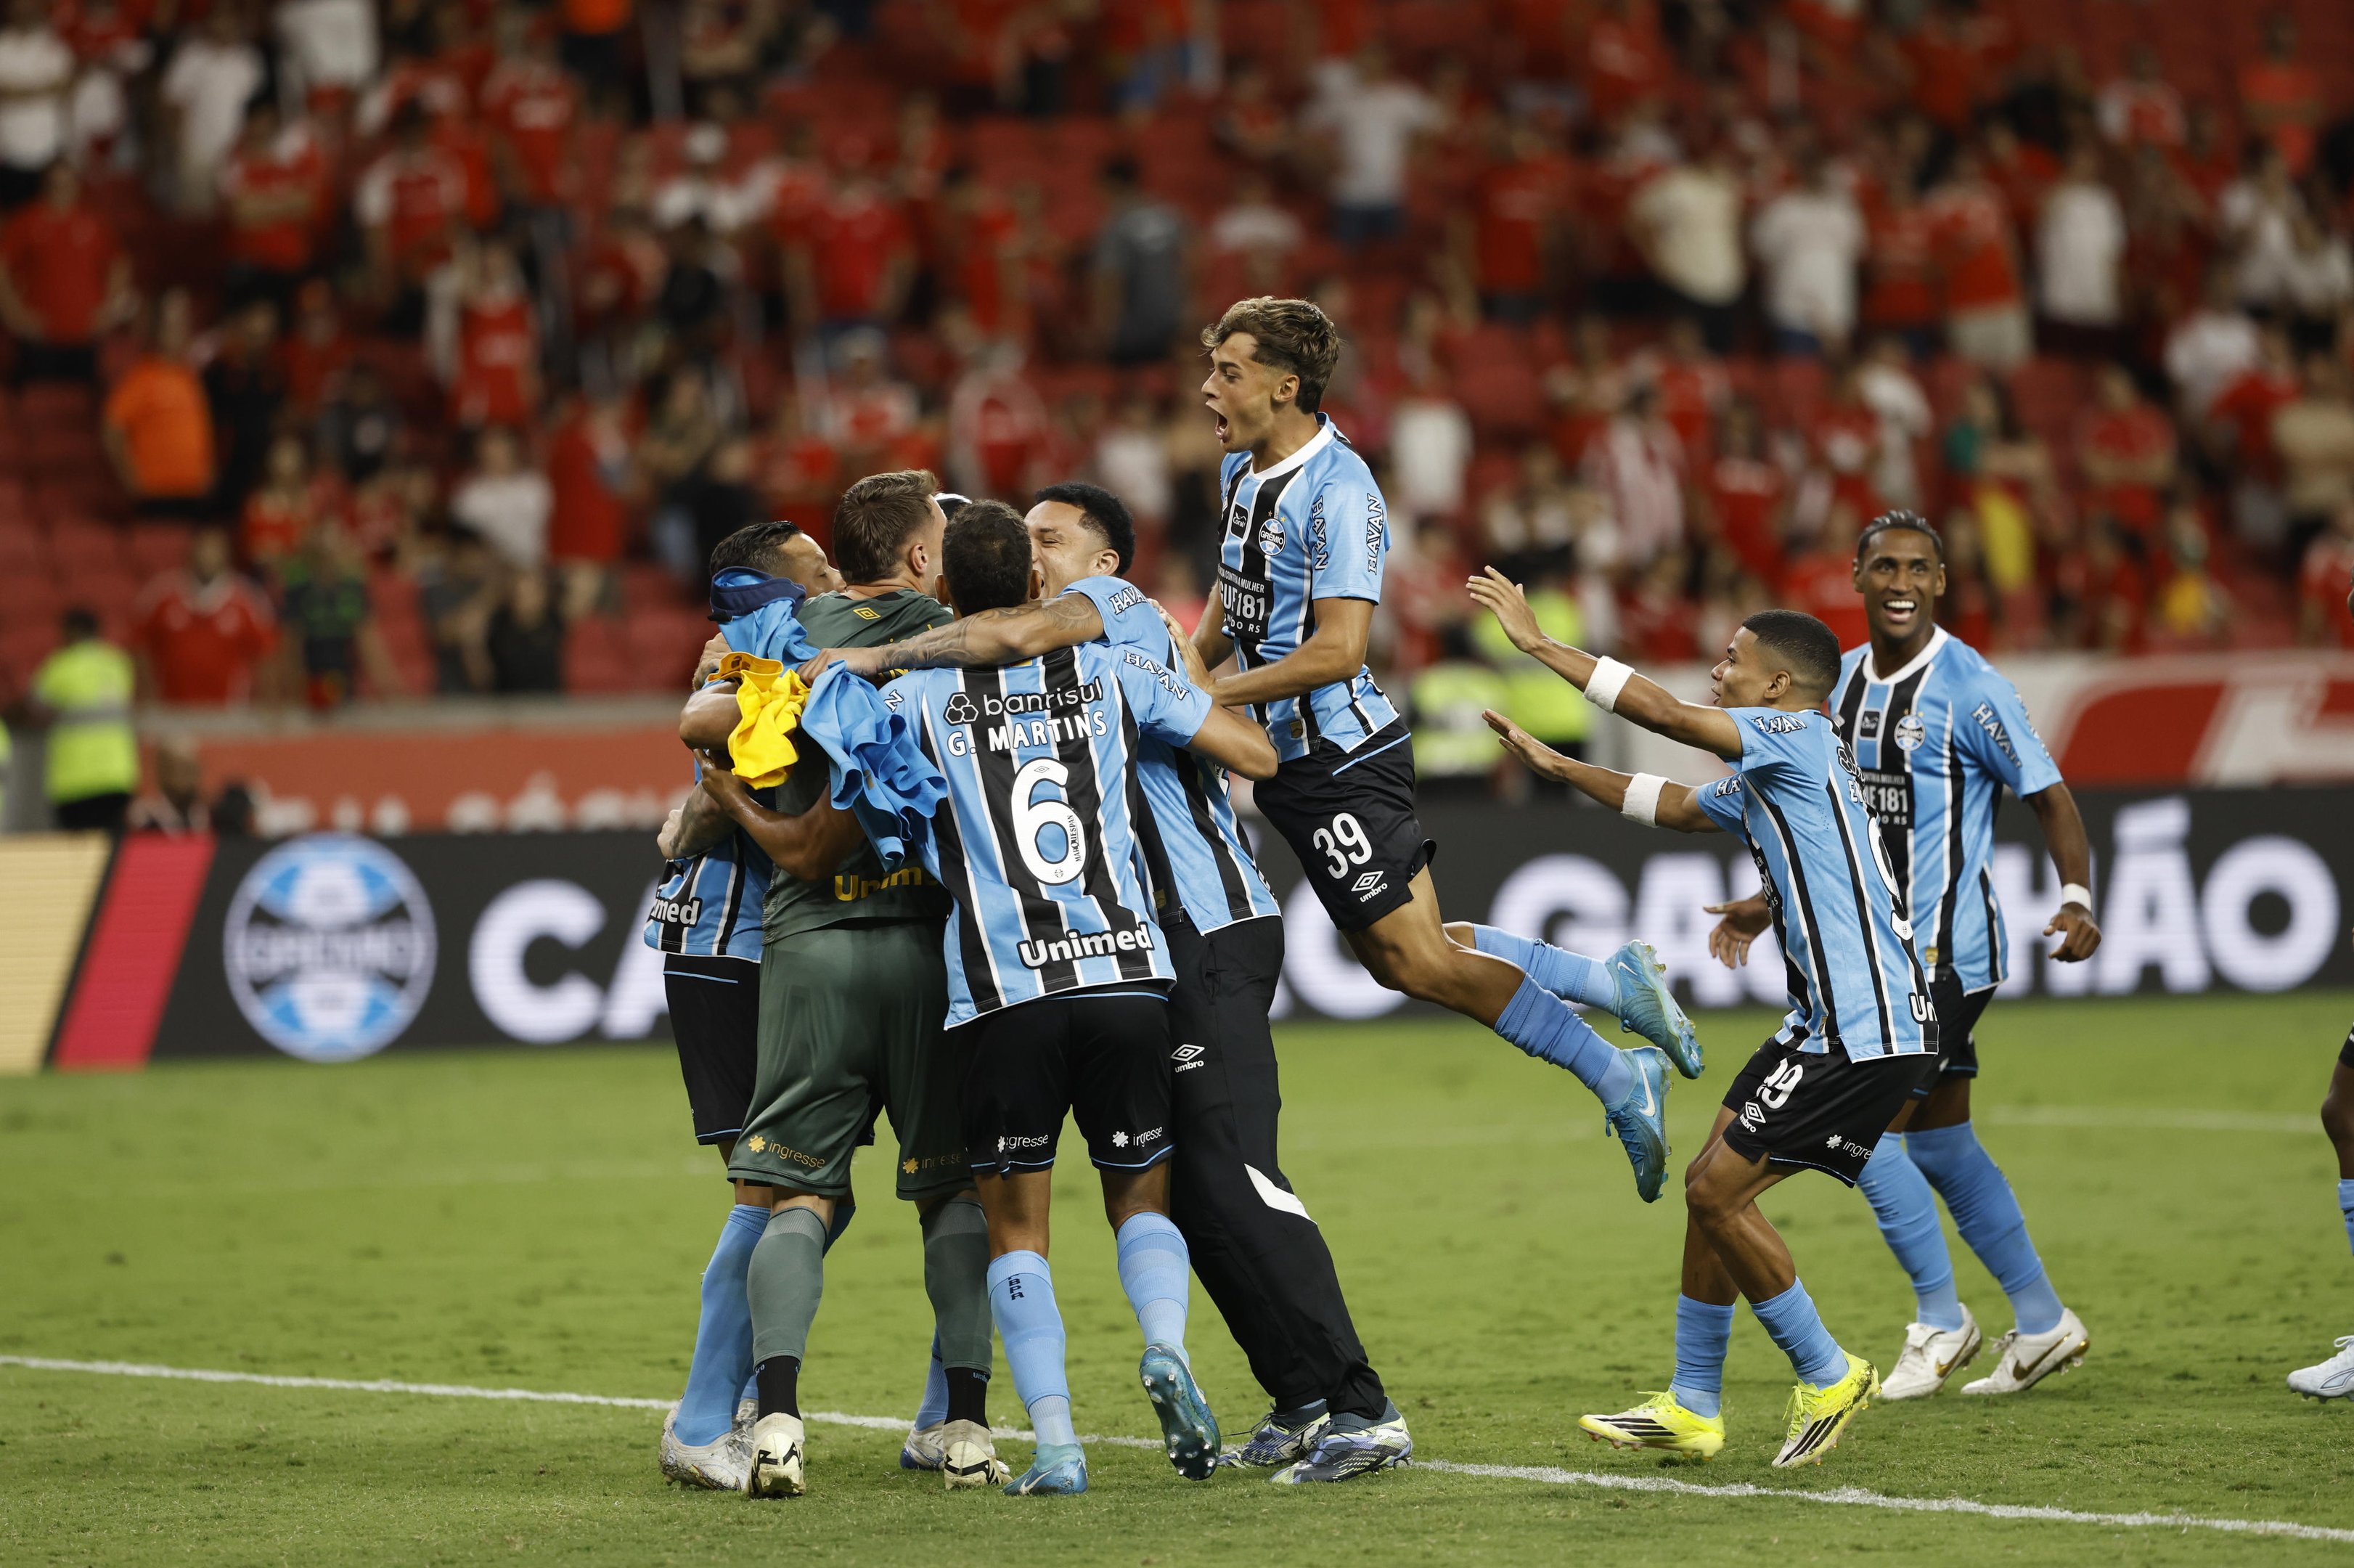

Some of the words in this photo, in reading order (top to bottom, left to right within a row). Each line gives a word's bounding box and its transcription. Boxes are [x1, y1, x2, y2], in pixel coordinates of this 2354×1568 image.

[1312, 495, 1329, 571] HAVAN
[1366, 493, 1384, 575] HAVAN
[1108, 586, 1148, 616] HAVA
[1241, 578, 1264, 593] MULHER
[1236, 592, 1265, 621] 181
[1248, 623, 1261, 634] RS
[1124, 650, 1189, 701] HAVAN
[983, 676, 1103, 716] banrisul
[947, 731, 976, 757] G.
[987, 711, 1108, 752] MARTINS
[1877, 786, 1908, 813] 181
[1010, 756, 1089, 886] 6
[1312, 812, 1373, 879] 39
[834, 866, 939, 902] Unim
[1360, 883, 1388, 902] umbro
[650, 891, 701, 926] imed
[1017, 921, 1155, 969] Unimed
[1174, 1060, 1204, 1073] umbro
[769, 1139, 825, 1169] ingresse
[1005, 1134, 1049, 1150] gresse
[1842, 1139, 1873, 1160] ingre
